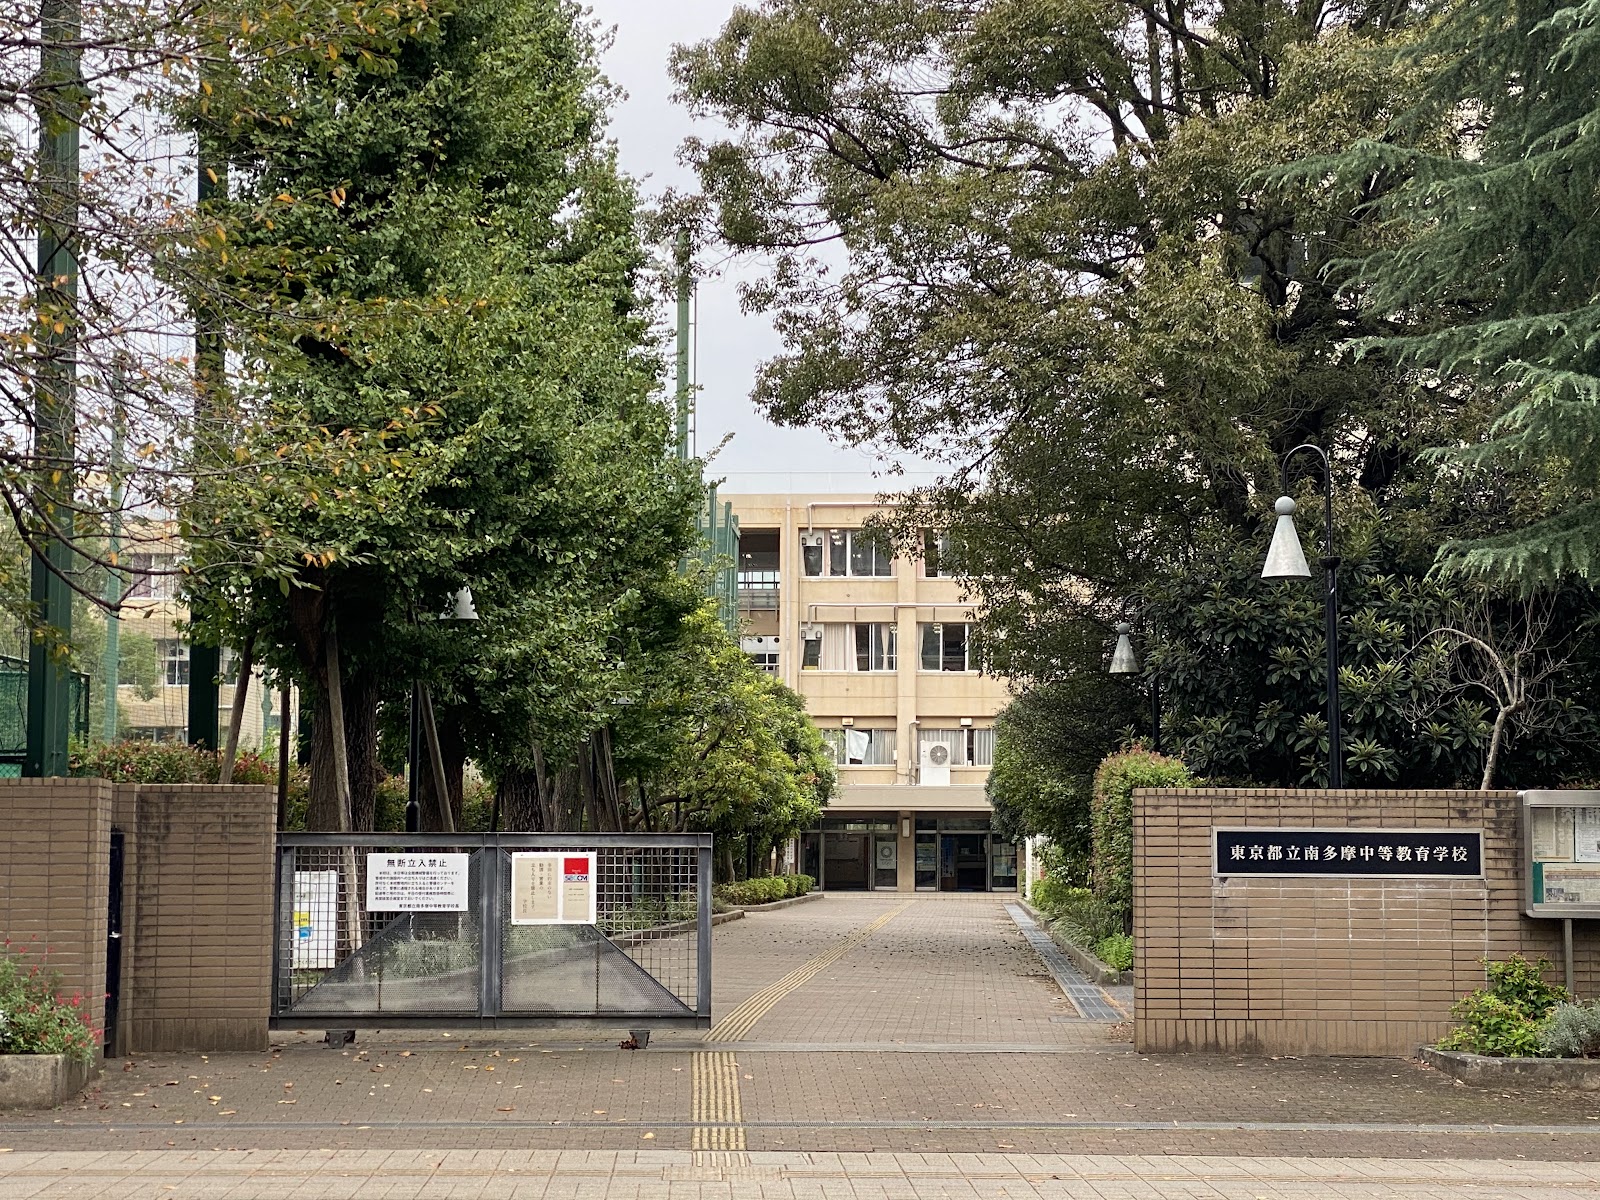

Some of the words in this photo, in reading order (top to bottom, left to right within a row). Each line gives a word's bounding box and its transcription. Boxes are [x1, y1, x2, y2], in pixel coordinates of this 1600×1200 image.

[1229, 844, 1469, 862] 東京都立南多摩中等教育学校
[386, 858, 448, 868] 無断立入禁止
